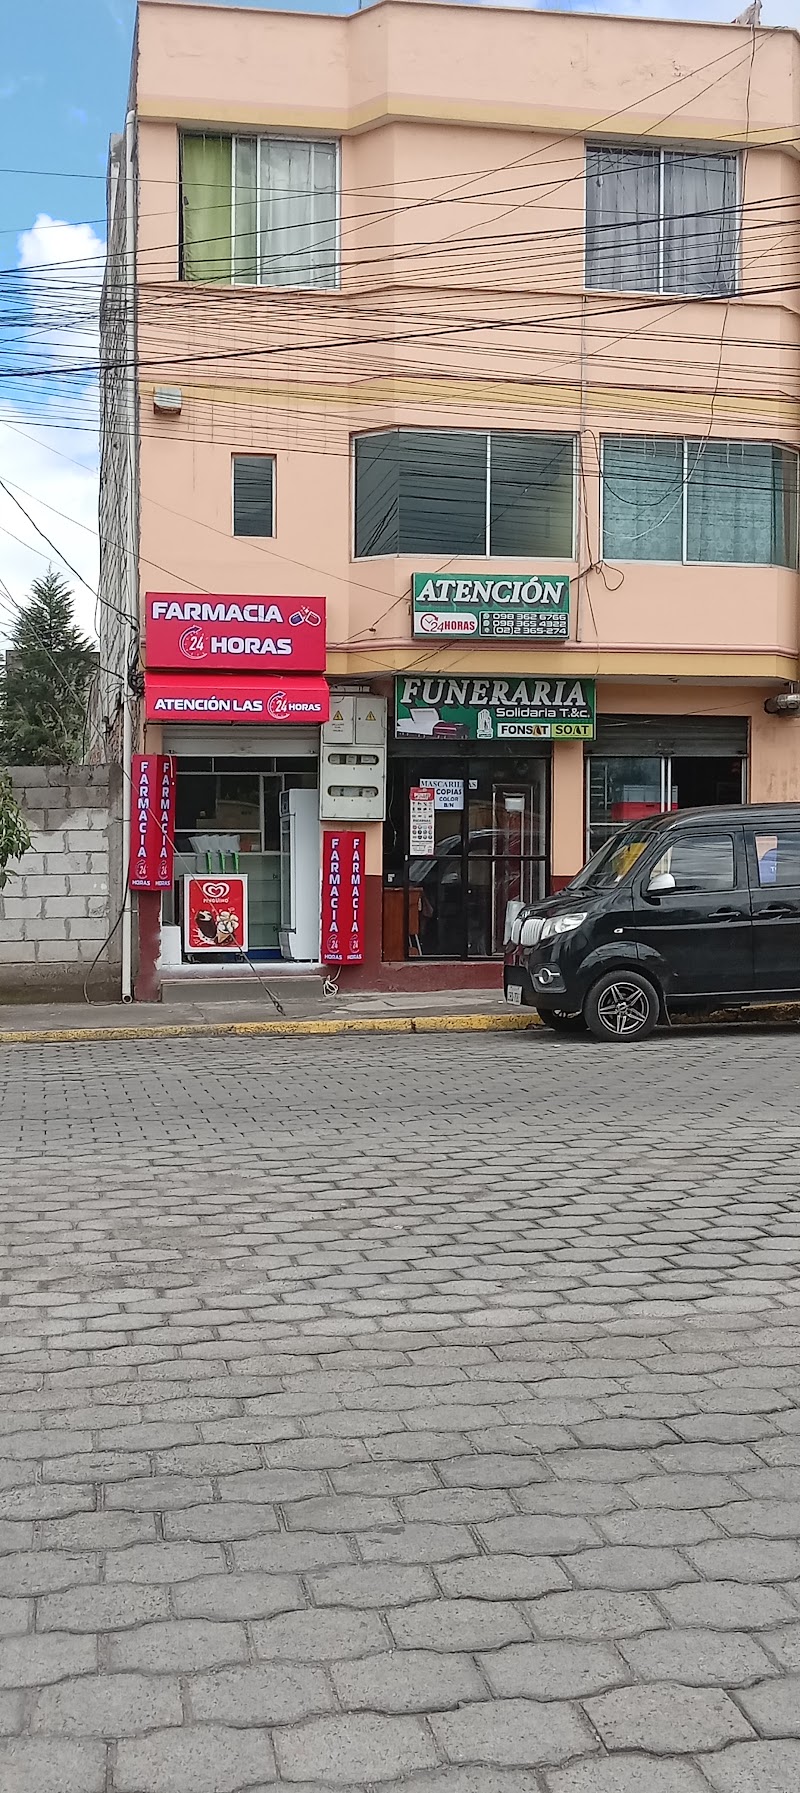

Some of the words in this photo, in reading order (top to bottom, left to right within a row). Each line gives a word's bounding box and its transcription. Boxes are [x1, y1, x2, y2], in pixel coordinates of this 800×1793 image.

[416, 576, 564, 604] ATENCIÓN
[152, 602, 283, 623] FARMACIA
[431, 622, 444, 632] 24
[444, 620, 475, 630] HORAS
[189, 636, 204, 651] 24
[211, 637, 292, 655] HORAS
[154, 696, 230, 711] ATENCIÓN
[233, 700, 263, 712] LAS
[275, 700, 287, 713] 24
[288, 703, 321, 711] HORAS
[400, 678, 586, 706] FUNERARIA
[496, 708, 556, 717] Solidaria
[137, 762, 149, 858] FARMACIA
[160, 762, 170, 858] FARMACIA
[329, 838, 340, 932] FARMACIA
[351, 838, 360, 932] FARMACIA
